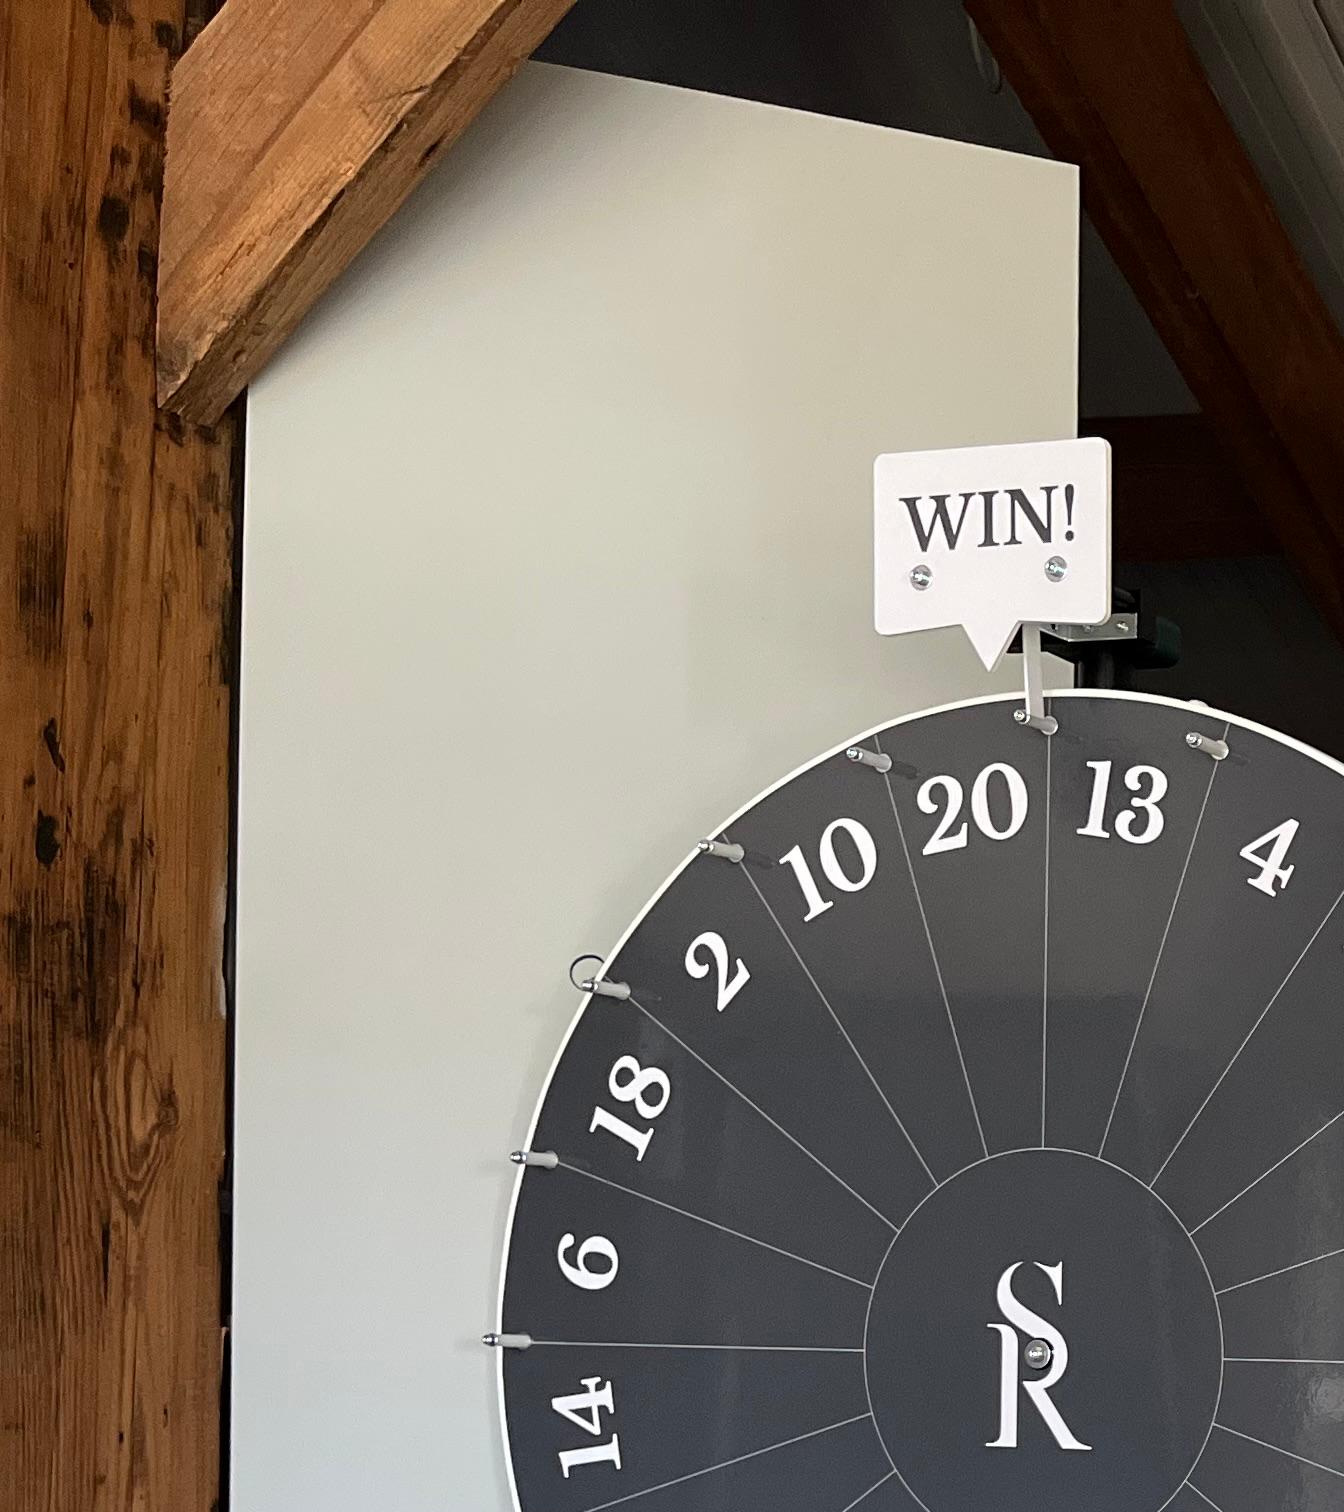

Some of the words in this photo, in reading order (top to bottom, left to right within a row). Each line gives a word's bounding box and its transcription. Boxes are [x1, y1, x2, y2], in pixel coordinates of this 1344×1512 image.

[898, 483, 1075, 553] WIN!
[917, 763, 1027, 855] 20
[1077, 761, 1167, 843] 13
[779, 818, 876, 921] 10
[1240, 819, 1299, 896] 4
[685, 932, 750, 1011] 2
[590, 1056, 670, 1161] 18
[558, 1234, 618, 1289] 6
[552, 1377, 621, 1478] 14
